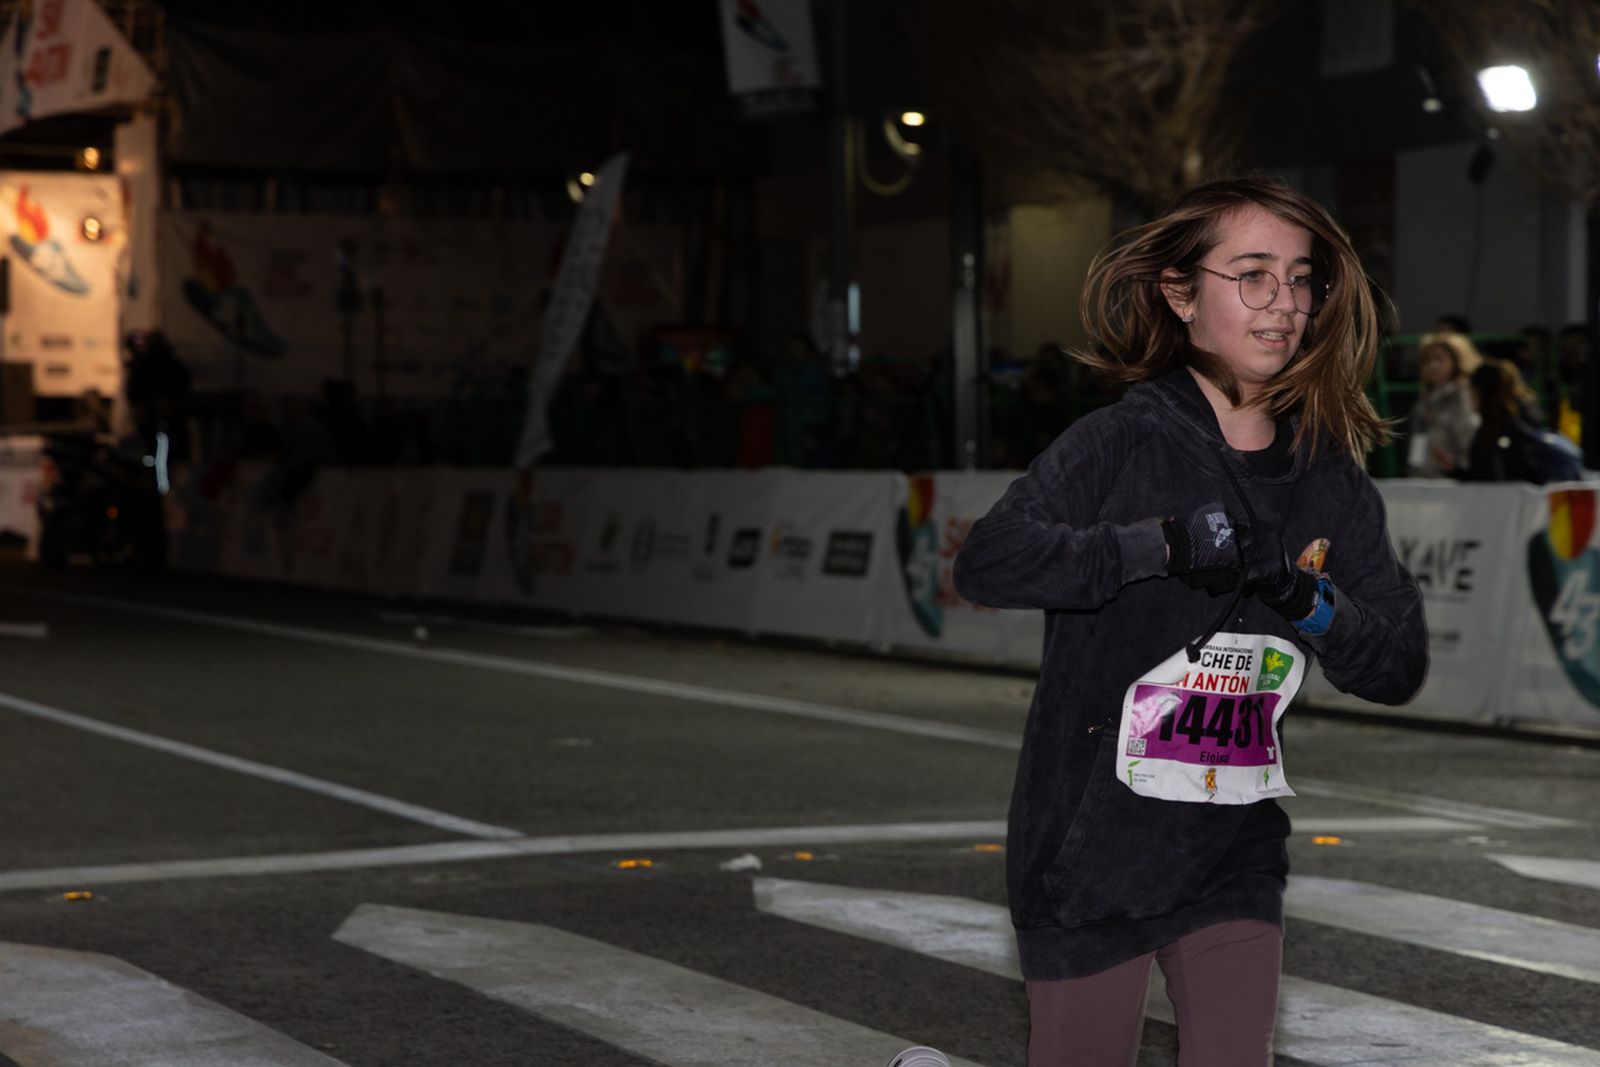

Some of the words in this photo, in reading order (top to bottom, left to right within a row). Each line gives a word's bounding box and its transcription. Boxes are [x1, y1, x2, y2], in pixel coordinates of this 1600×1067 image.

[1201, 652, 1233, 669] CHE
[1236, 655, 1253, 671] DE
[1192, 671, 1250, 693] ANTÓN
[1159, 694, 1264, 748] 14431
